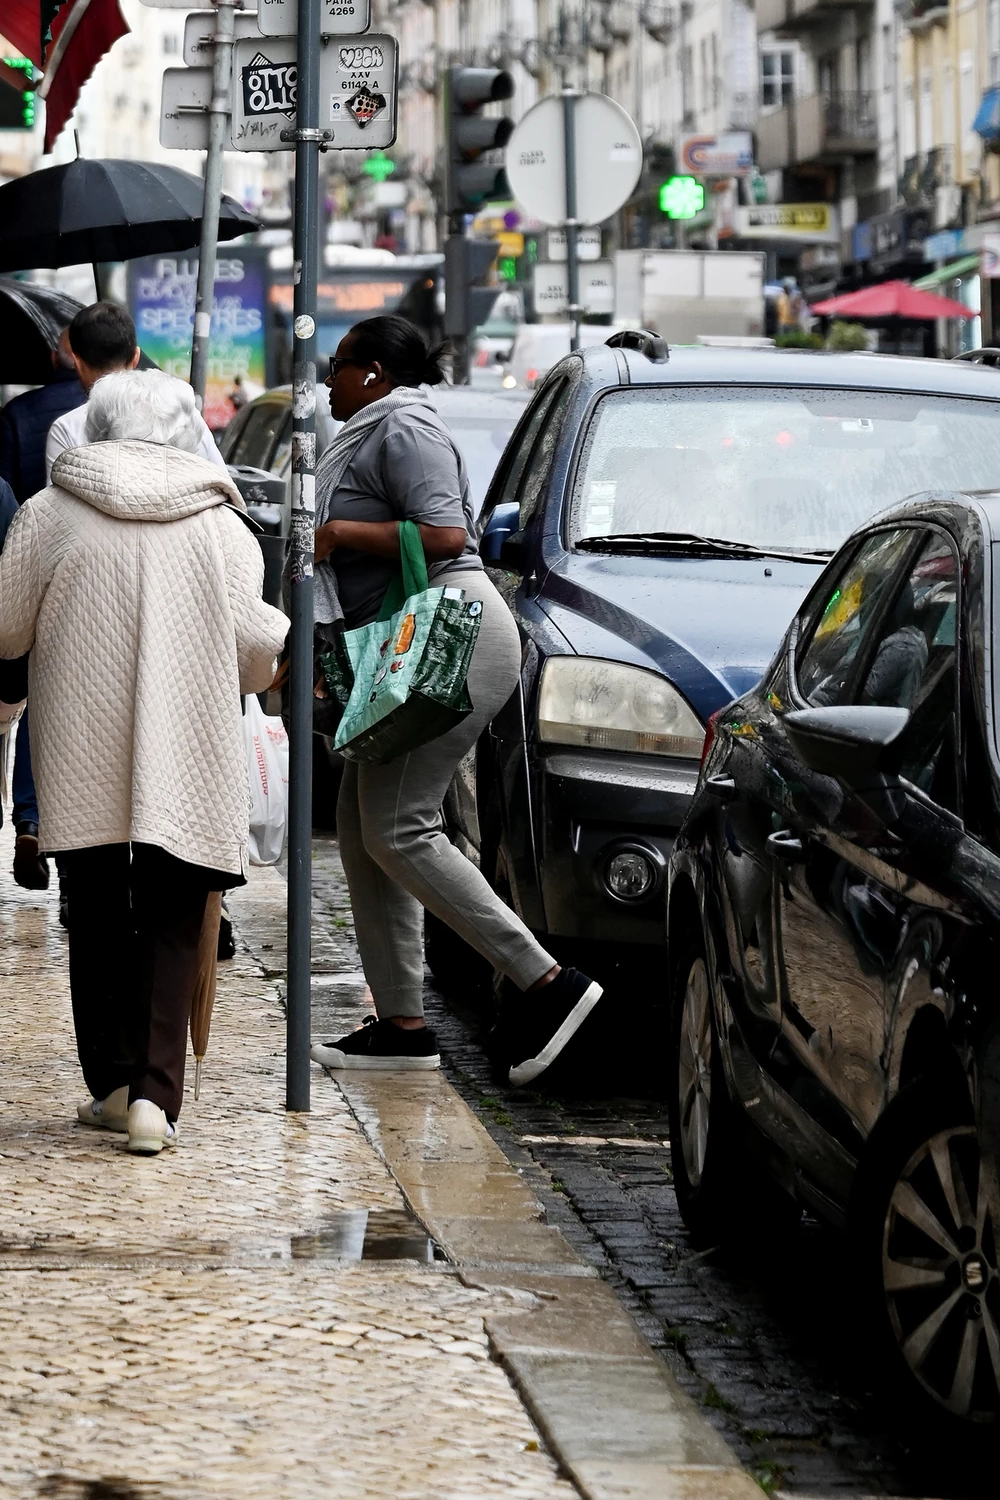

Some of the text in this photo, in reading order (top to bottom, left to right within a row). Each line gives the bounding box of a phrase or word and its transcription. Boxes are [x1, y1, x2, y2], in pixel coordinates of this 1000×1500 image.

[329, 6, 355, 16] 4269
[350, 71, 371, 79] XXV
[158, 259, 245, 283] FLUES
[140, 308, 262, 331] SPERES
[156, 359, 251, 379] IGTER
